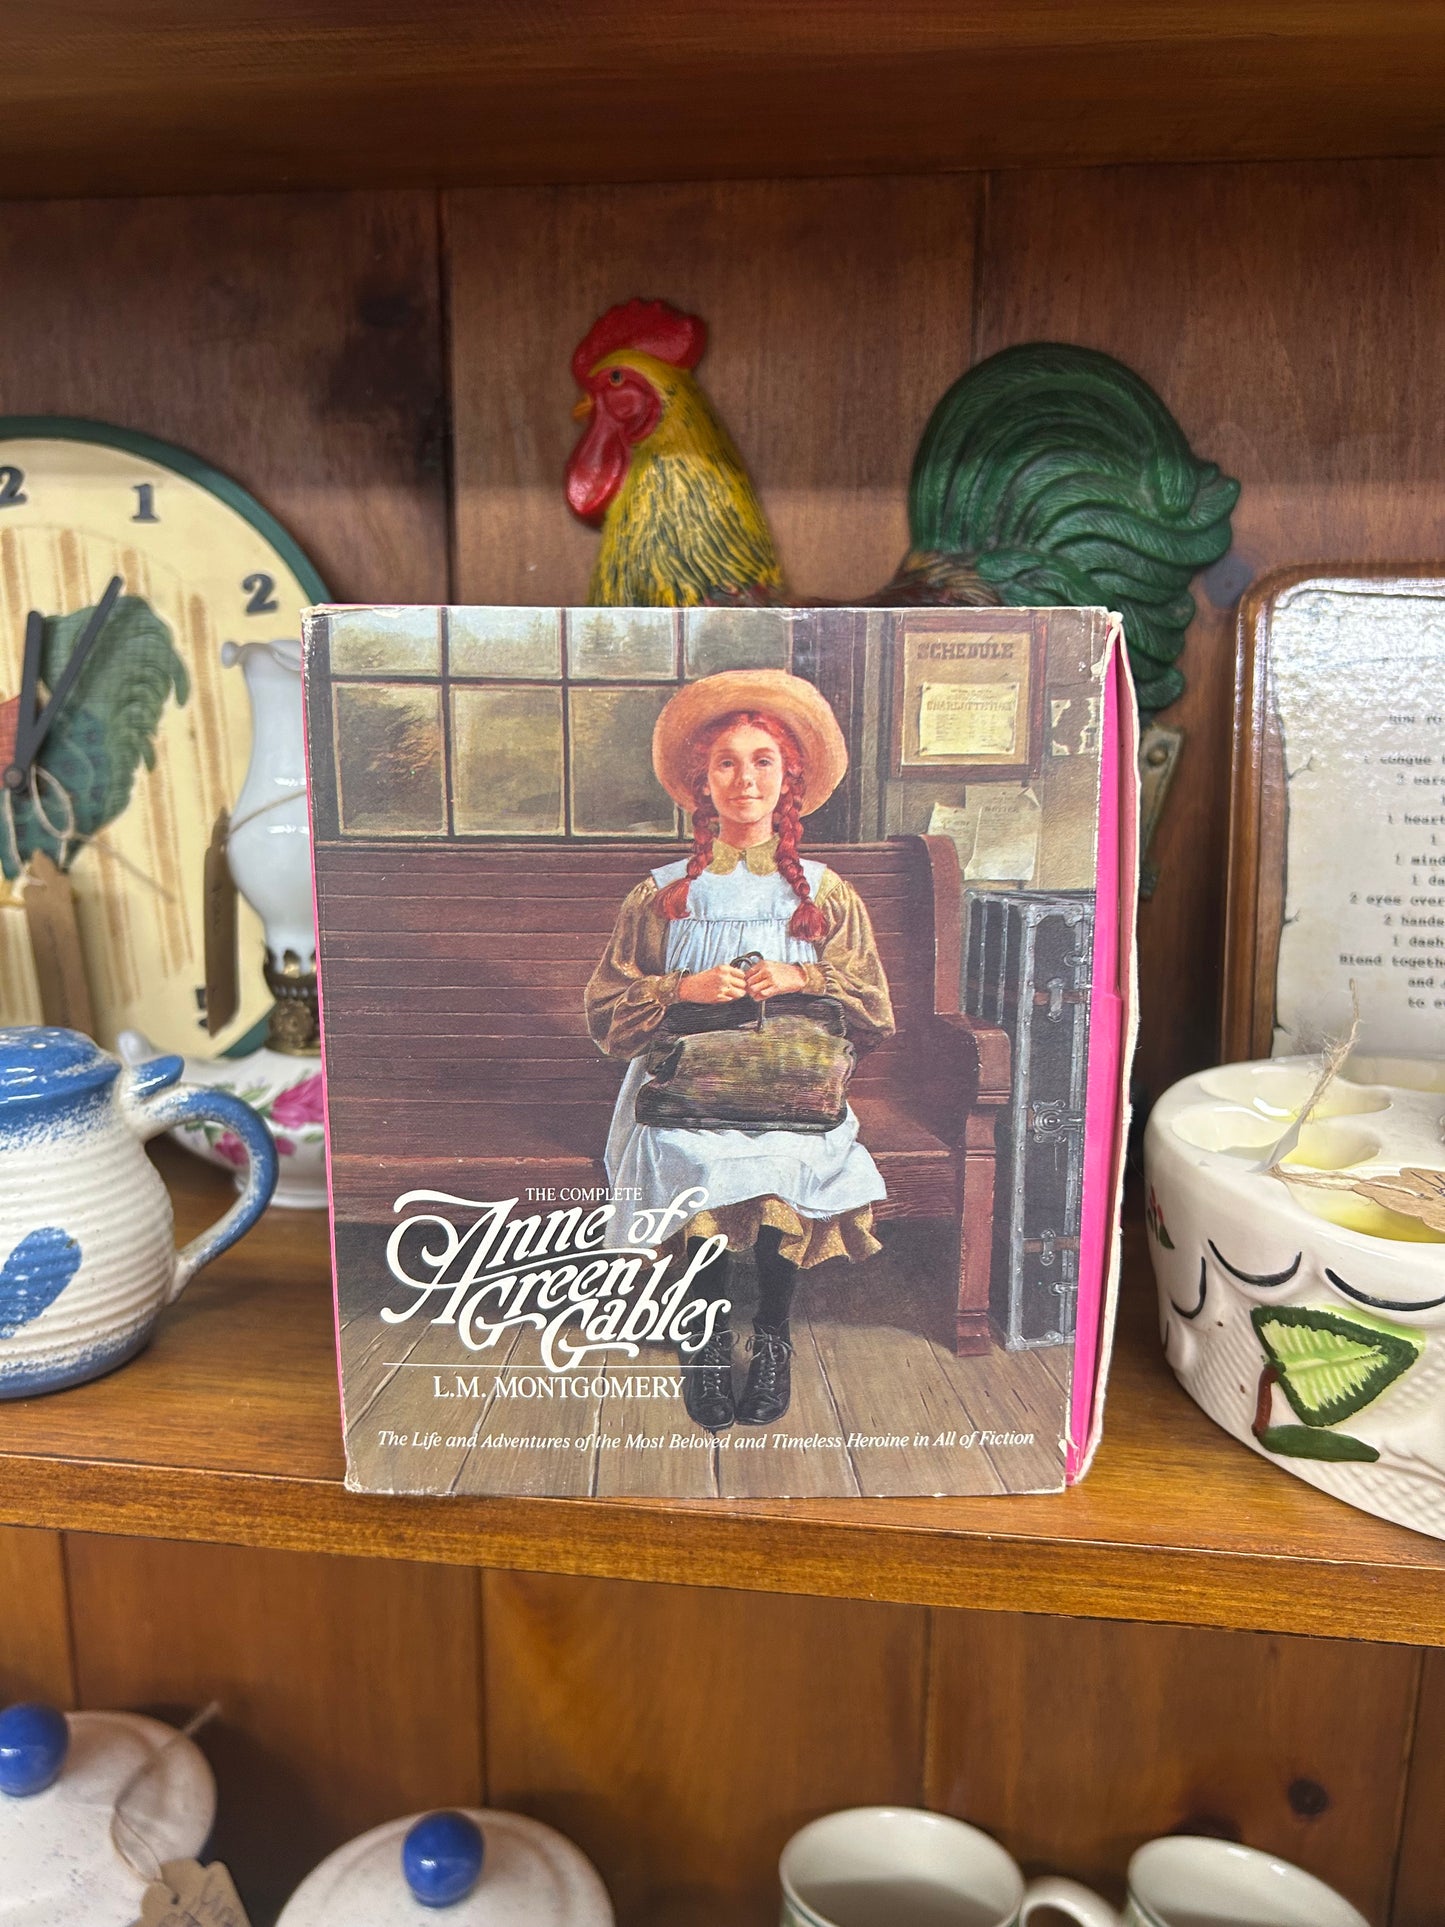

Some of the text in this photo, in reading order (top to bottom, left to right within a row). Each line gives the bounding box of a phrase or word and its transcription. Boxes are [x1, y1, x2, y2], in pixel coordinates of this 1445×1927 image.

[132, 483, 159, 522] 1
[242, 573, 278, 615] 2
[917, 642, 1014, 660] SCHEDULE
[1408, 977, 1434, 988] and
[1408, 997, 1425, 1008] to
[525, 1187, 643, 1201] THE COMPLETE
[380, 1186, 710, 1325] Anne of
[457, 1257, 638, 1351] Green
[540, 1233, 732, 1373] Gables
[433, 1375, 686, 1399] L.M. MONTGOMERY
[378, 1430, 1035, 1452] The Life and Adventures of the Most Beloved and Timeless Heroine in All of Fiction
